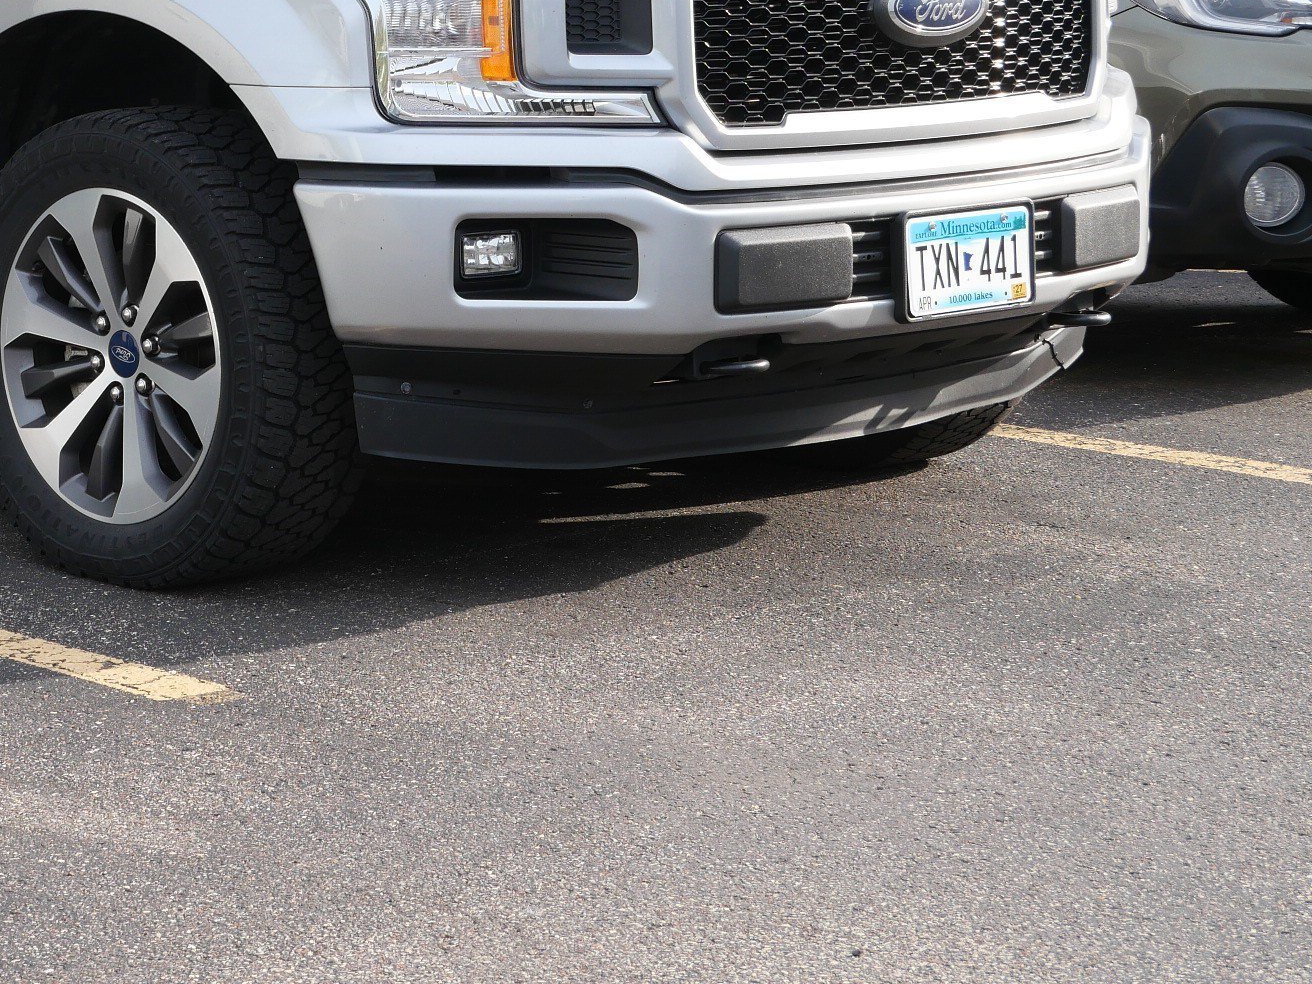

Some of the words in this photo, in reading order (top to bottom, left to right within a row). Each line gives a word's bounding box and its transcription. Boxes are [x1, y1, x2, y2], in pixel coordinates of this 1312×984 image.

[915, 241, 961, 292] TXN
[979, 233, 1023, 283] 441
[918, 296, 932, 311] APR
[973, 291, 994, 301] lakes
